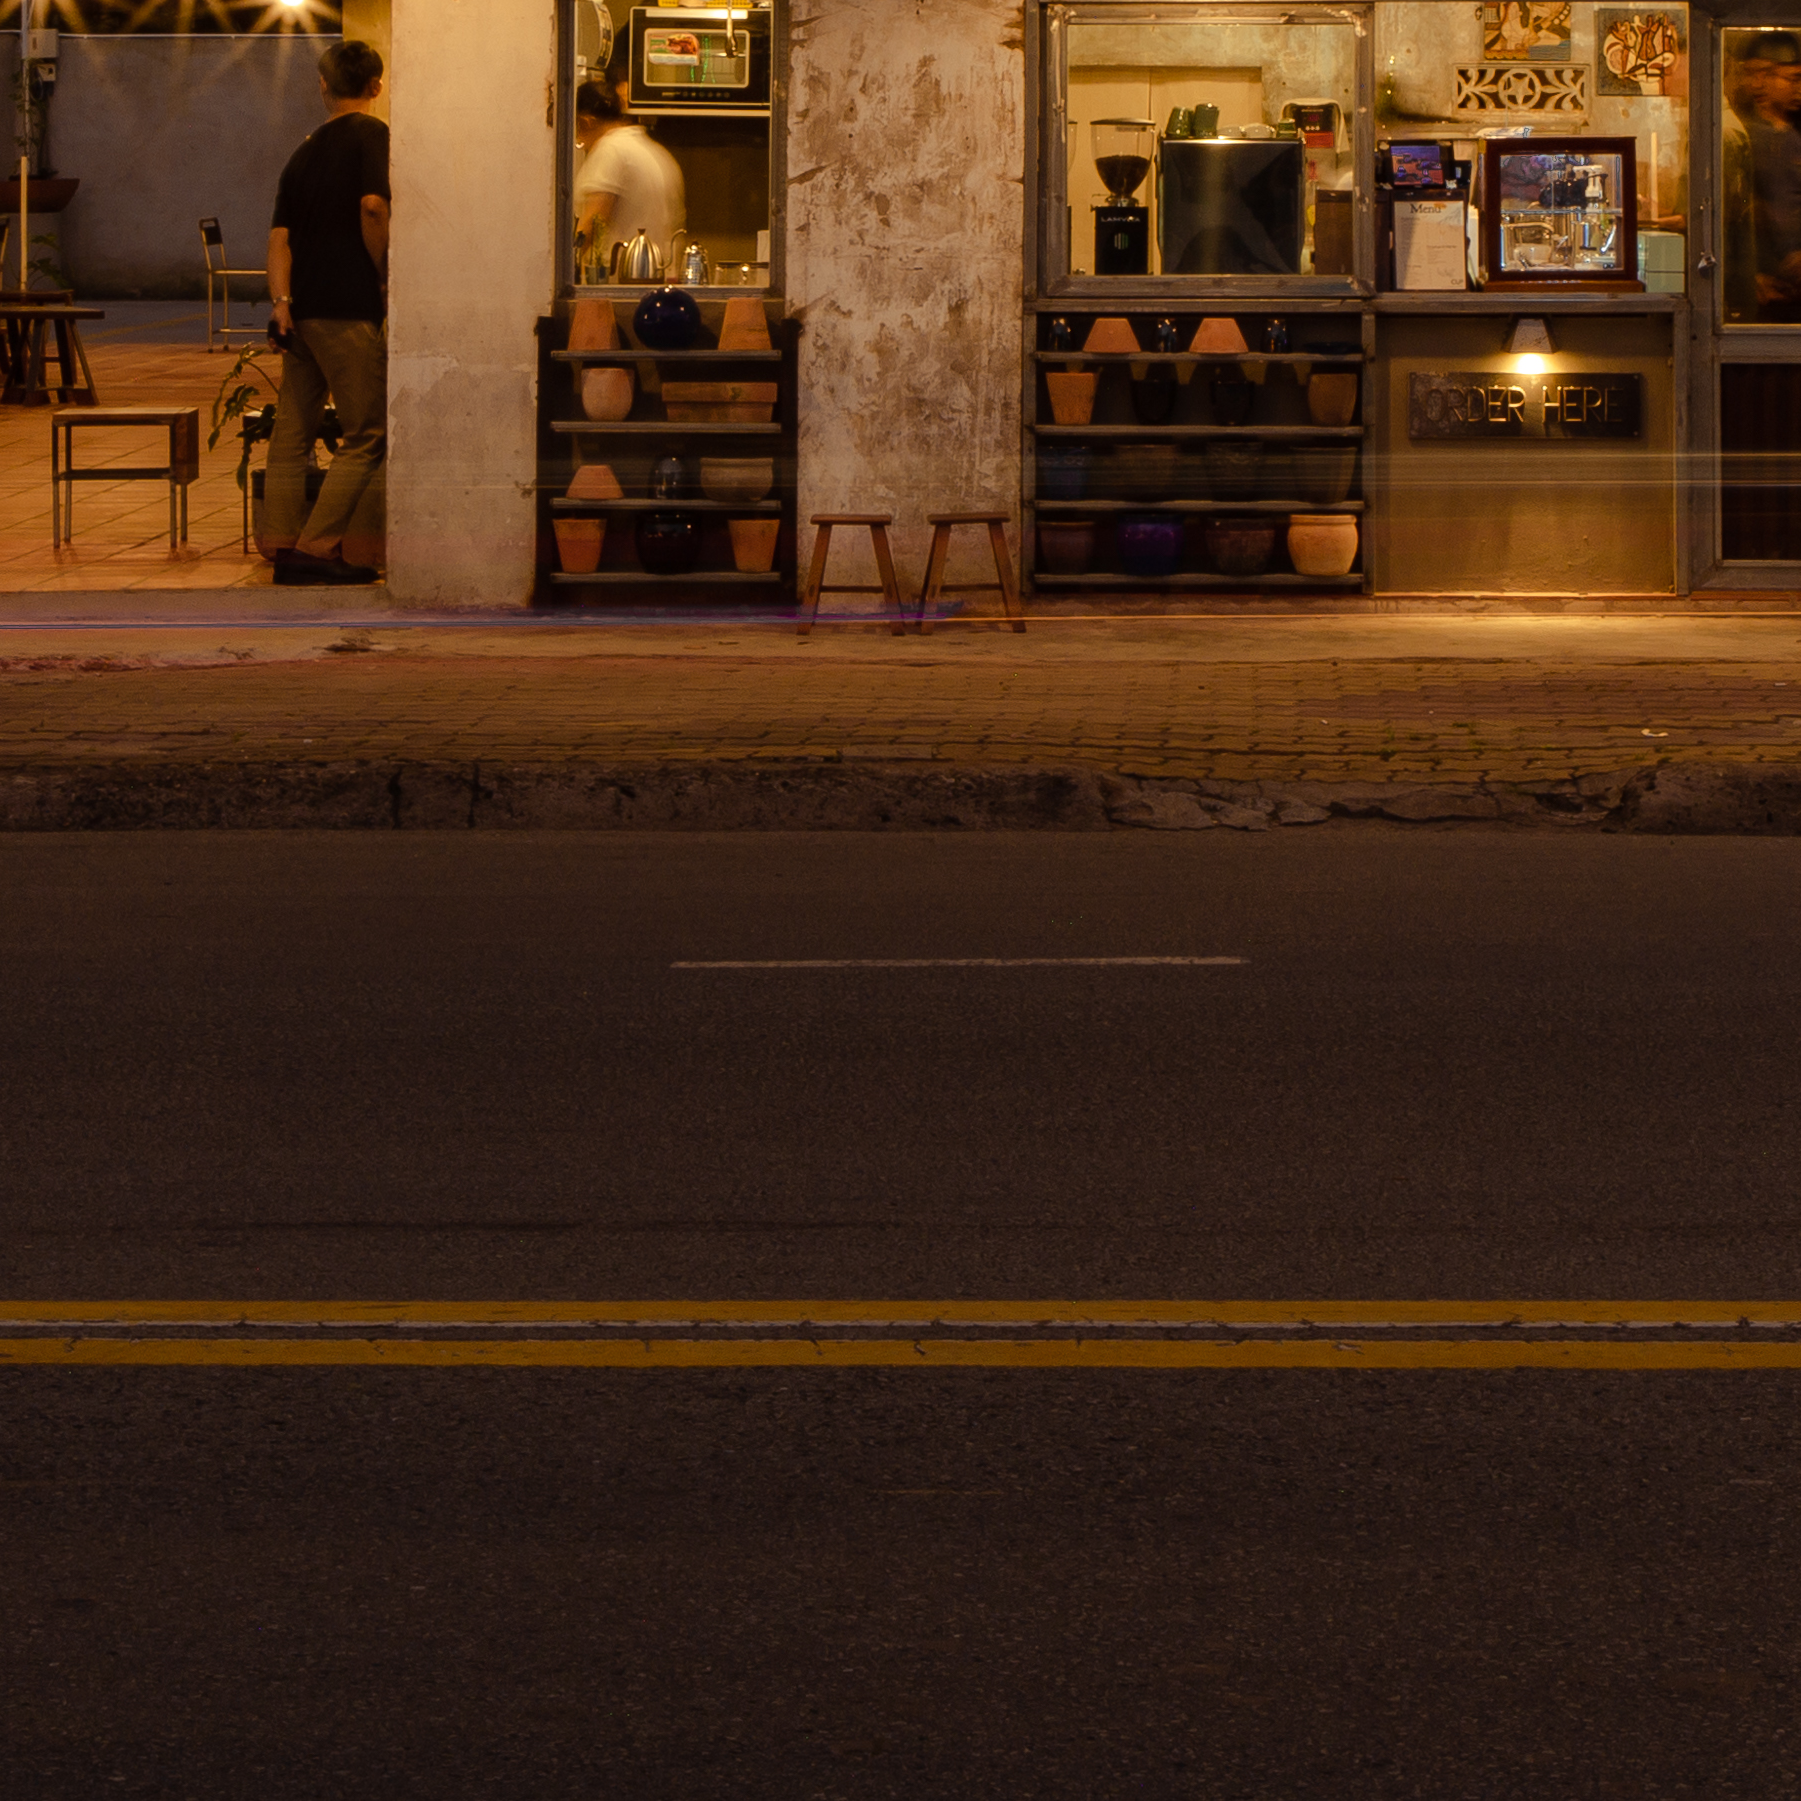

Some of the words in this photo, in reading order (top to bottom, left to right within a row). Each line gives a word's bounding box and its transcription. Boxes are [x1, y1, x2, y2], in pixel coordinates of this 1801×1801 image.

[1410, 203, 1442, 214] Menu
[1425, 384, 1527, 424] ORDER
[1541, 384, 1625, 424] HERE
